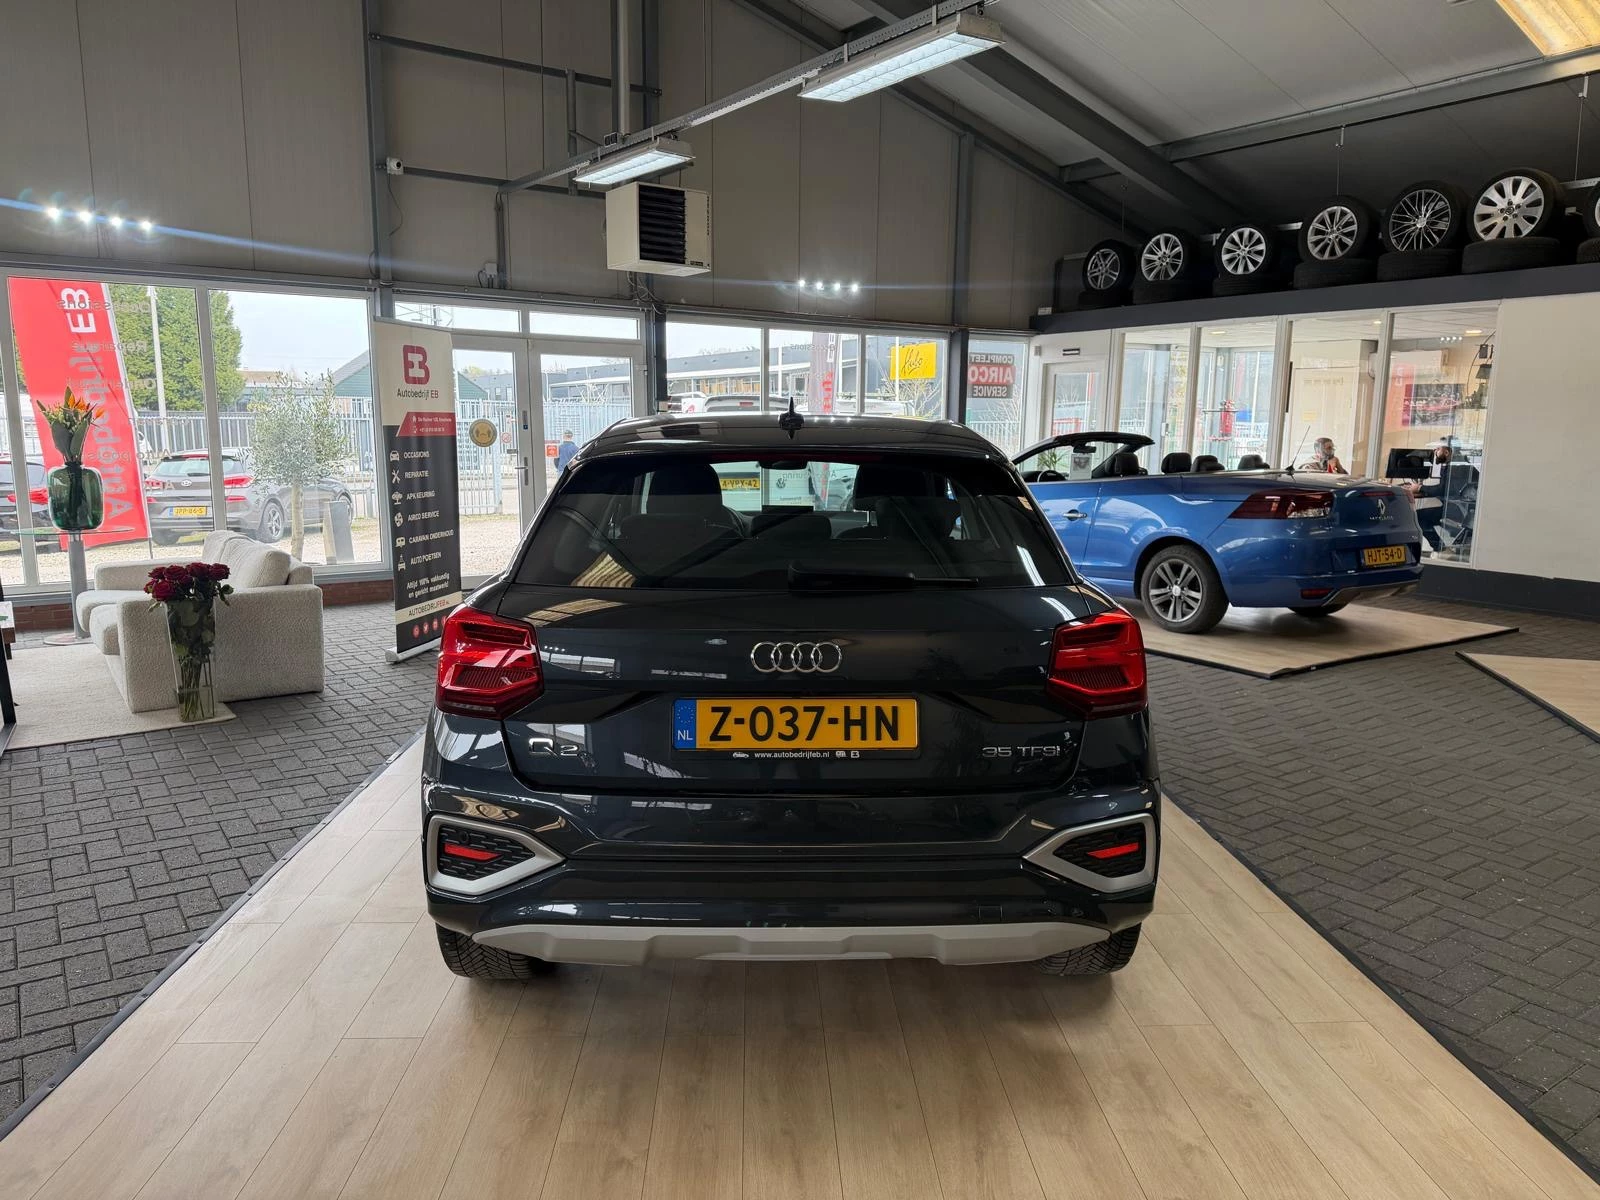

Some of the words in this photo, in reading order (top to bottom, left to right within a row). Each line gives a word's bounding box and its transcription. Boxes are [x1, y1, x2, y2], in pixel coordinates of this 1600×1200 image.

[397, 389, 429, 400] Autobedrijf
[431, 390, 439, 399] EB
[403, 451, 430, 459] OCCASIONS
[1367, 548, 1402, 563] HJT-54-D
[709, 705, 899, 742] Z-037-HN
[677, 730, 693, 741] NL
[754, 750, 830, 759] www.autobedrijfeb.nl
[982, 746, 1012, 757] 35
